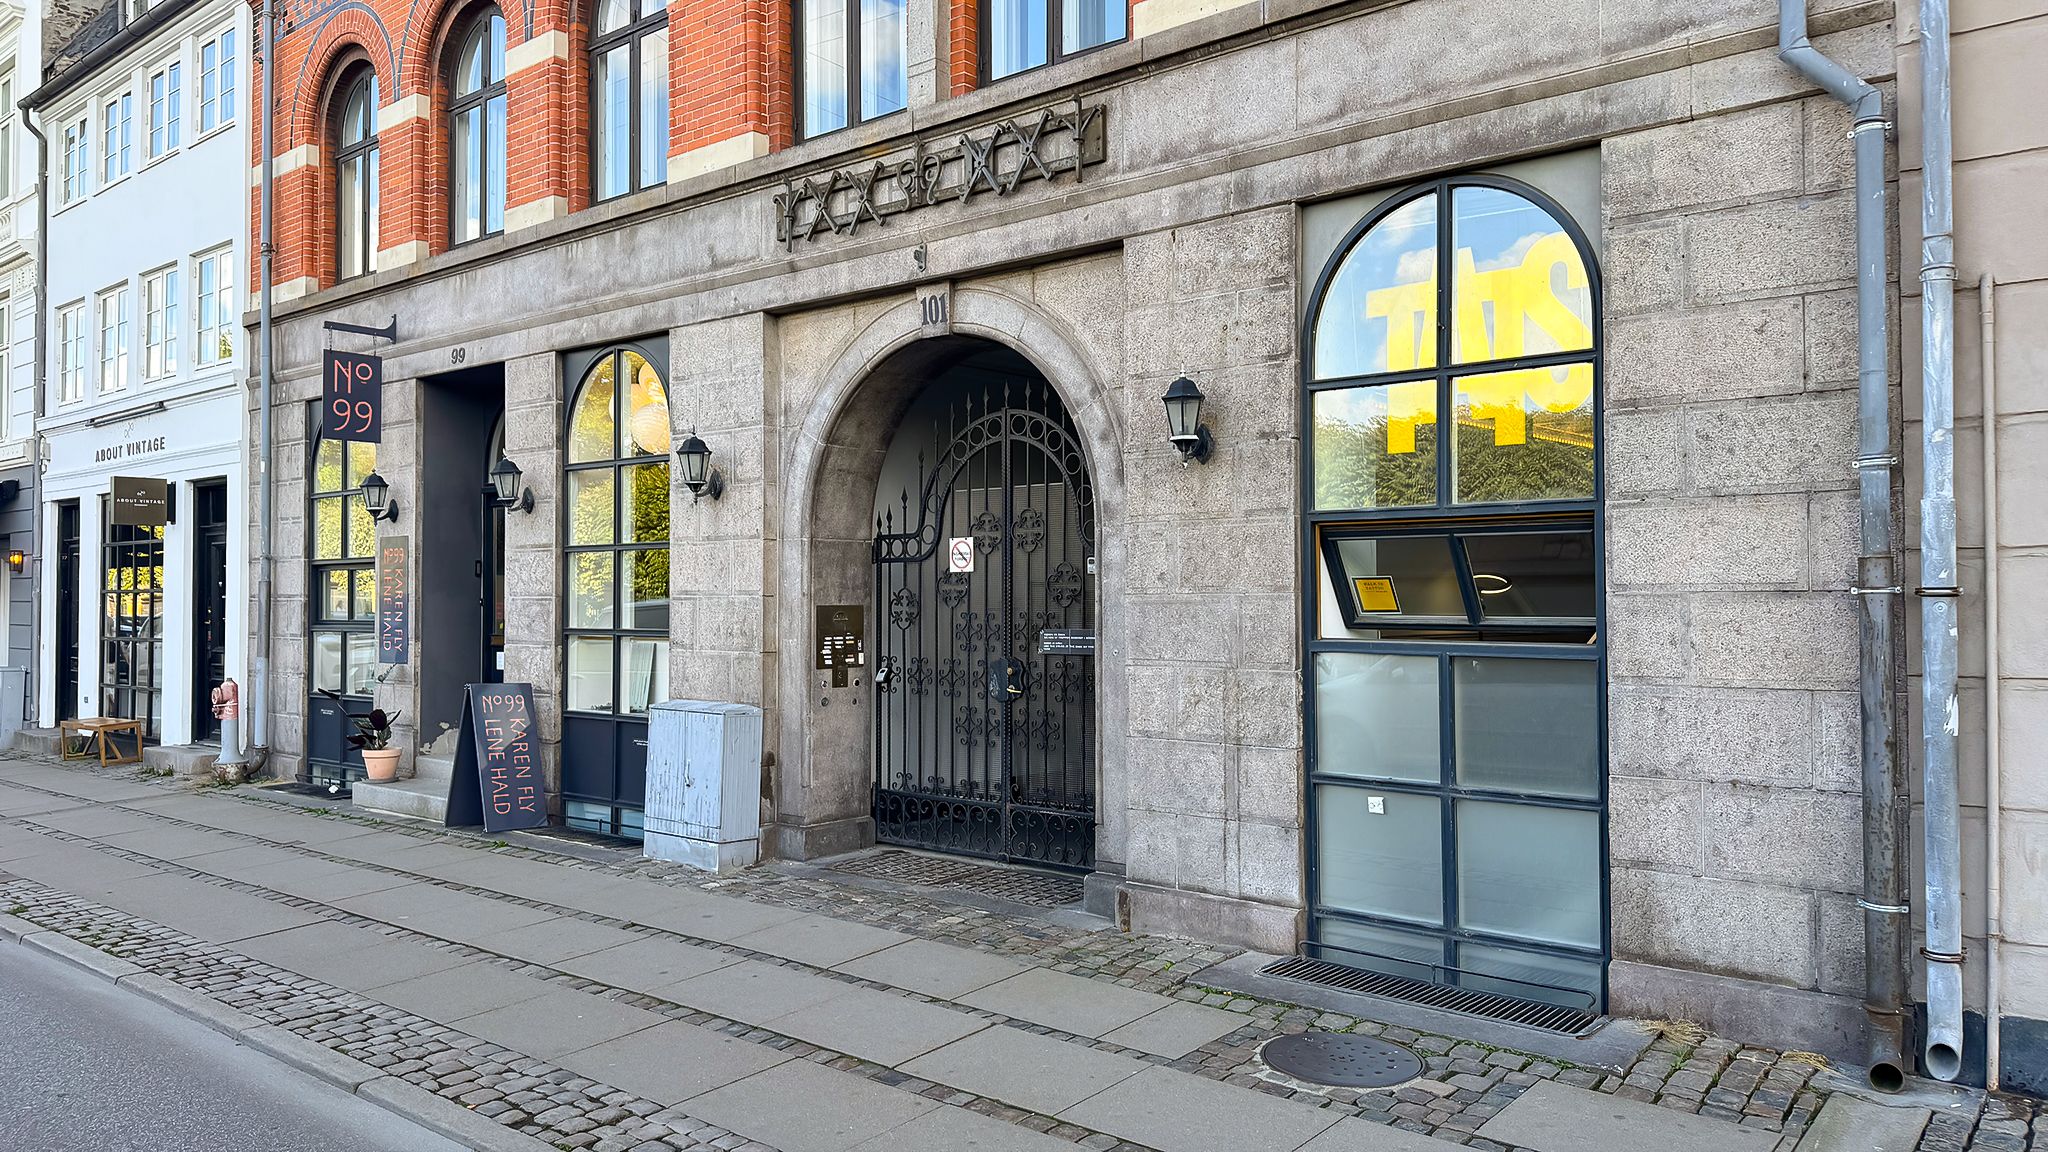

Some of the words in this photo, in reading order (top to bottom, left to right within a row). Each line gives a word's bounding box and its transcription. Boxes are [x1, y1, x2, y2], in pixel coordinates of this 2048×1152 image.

[920, 292, 948, 325] 101
[451, 347, 466, 365] 99
[332, 398, 373, 433] 99
[95, 444, 123, 463] ABOUT
[126, 436, 166, 456] VINTAGE
[383, 569, 393, 605] LENE
[394, 568, 404, 622] KAREN
[383, 611, 392, 651] HALD
[394, 629, 403, 652] FLY
[504, 694, 525, 713] 99
[484, 719, 506, 761] LENE
[509, 718, 532, 779] KAREN
[490, 767, 511, 815] HALD
[517, 786, 536, 813] FLY
